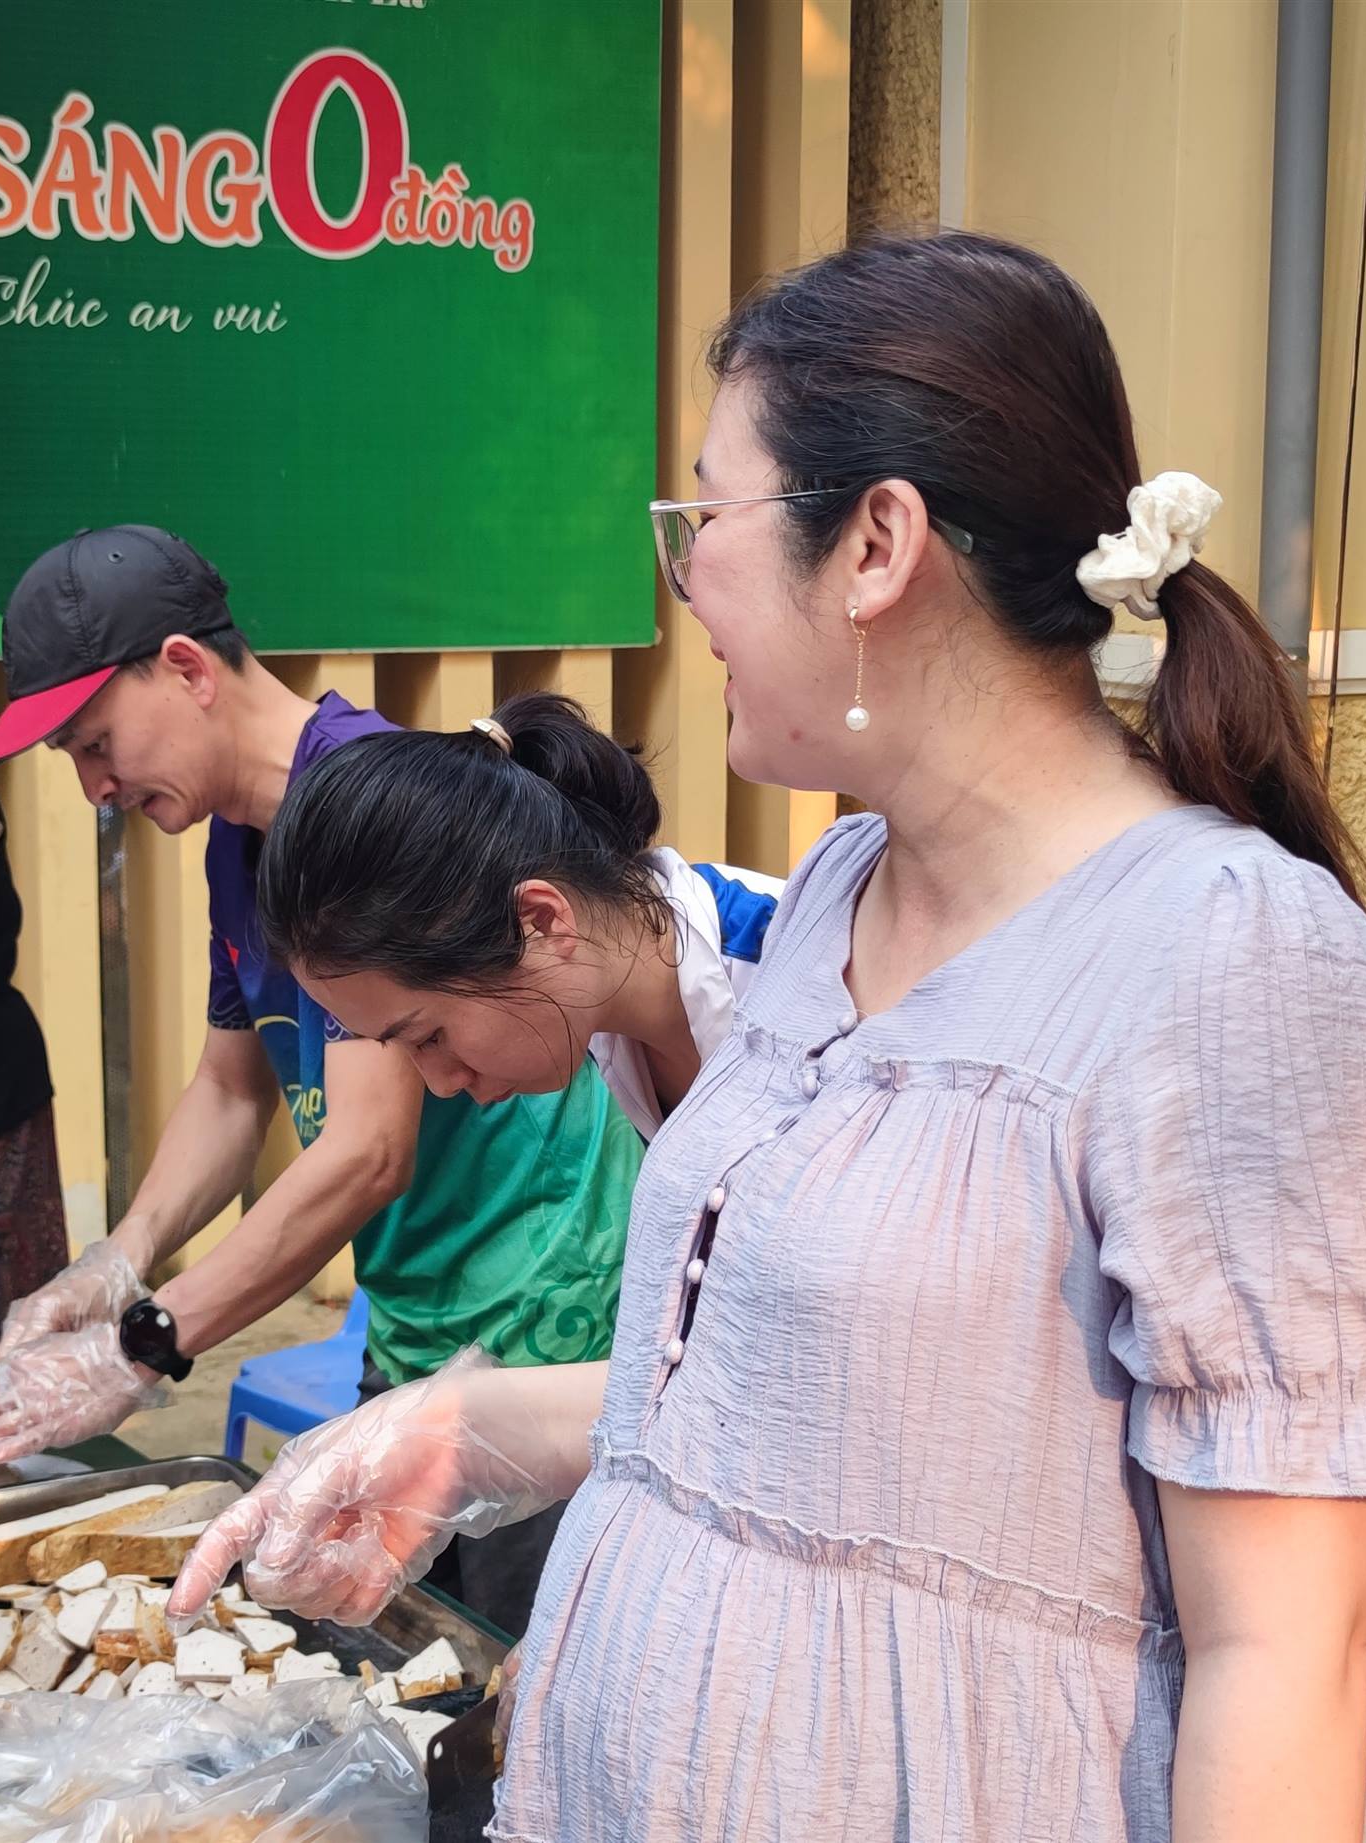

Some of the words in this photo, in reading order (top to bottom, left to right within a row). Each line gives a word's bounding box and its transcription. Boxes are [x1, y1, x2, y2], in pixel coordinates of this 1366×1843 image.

[380, 163, 535, 272] đồng
[129, 301, 193, 333] an
[213, 301, 287, 334] vui
